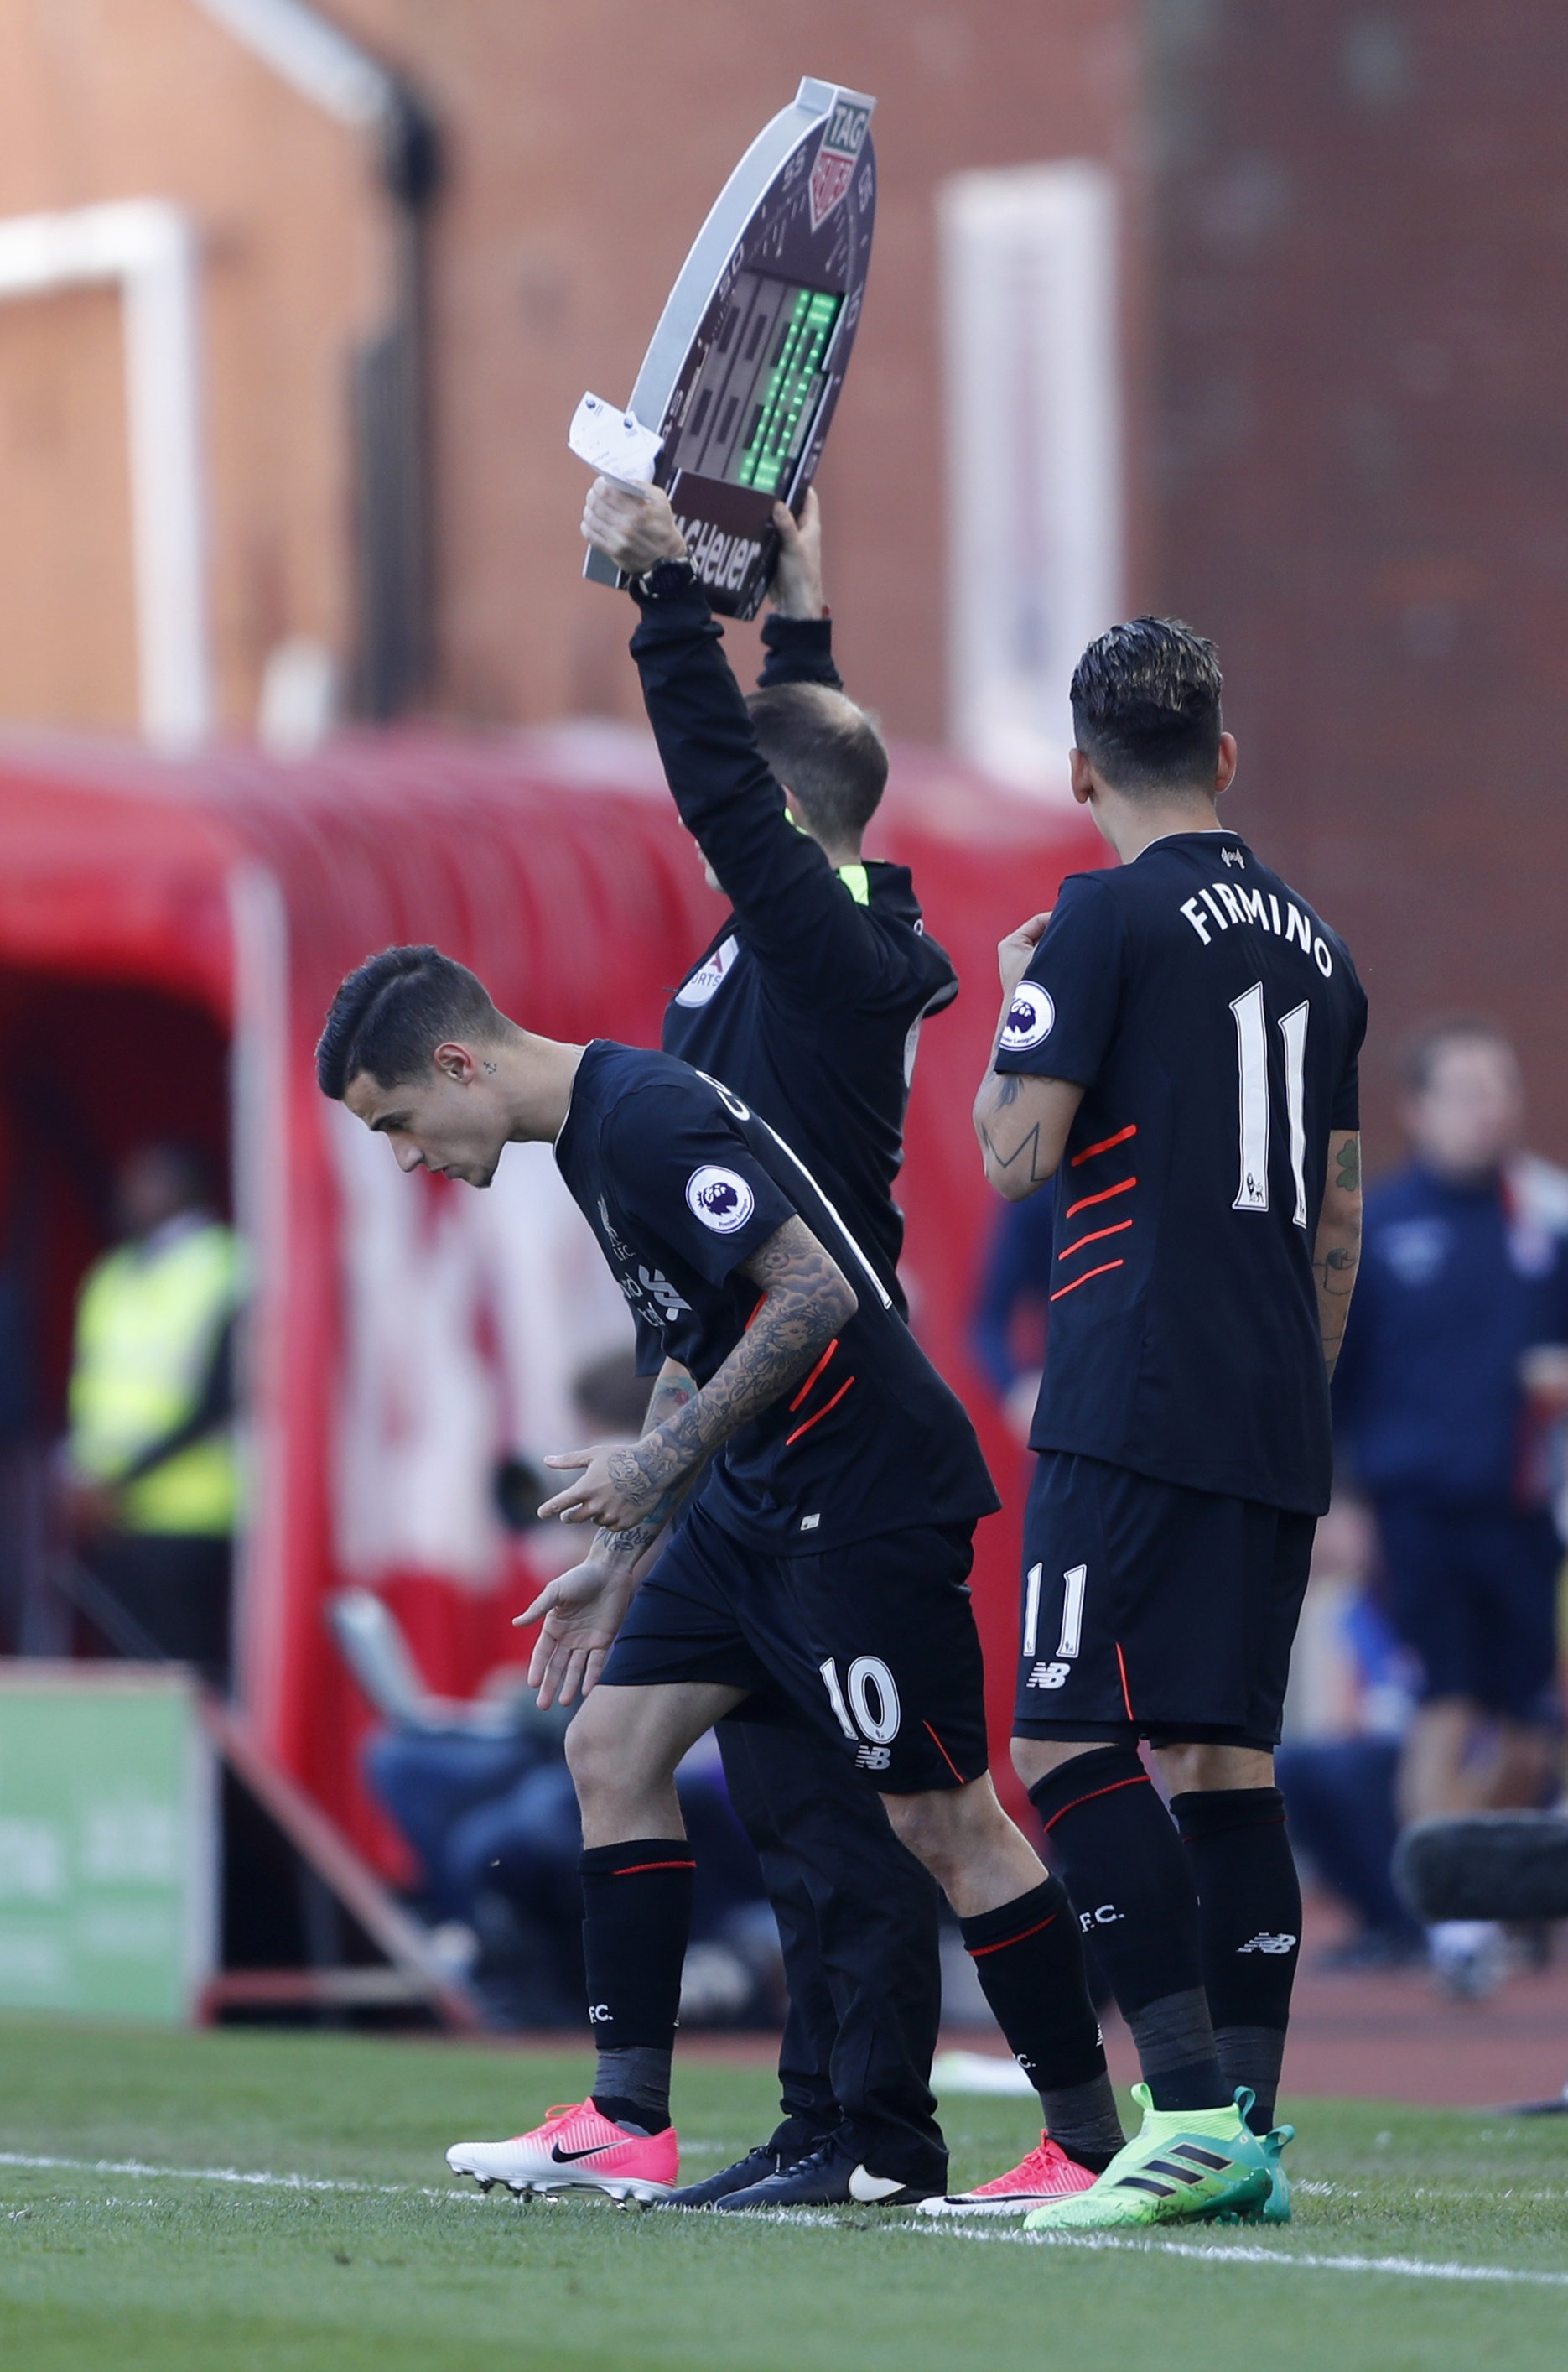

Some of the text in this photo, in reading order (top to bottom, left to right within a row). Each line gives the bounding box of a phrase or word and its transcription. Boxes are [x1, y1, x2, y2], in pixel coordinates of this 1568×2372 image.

[829, 106, 865, 149] TAG
[813, 154, 855, 216] HEUER
[1180, 883, 1332, 978] FIRMINO
[1229, 981, 1310, 1229] 11
[1023, 1562, 1087, 1658] 11
[819, 1655, 901, 1744] 10
